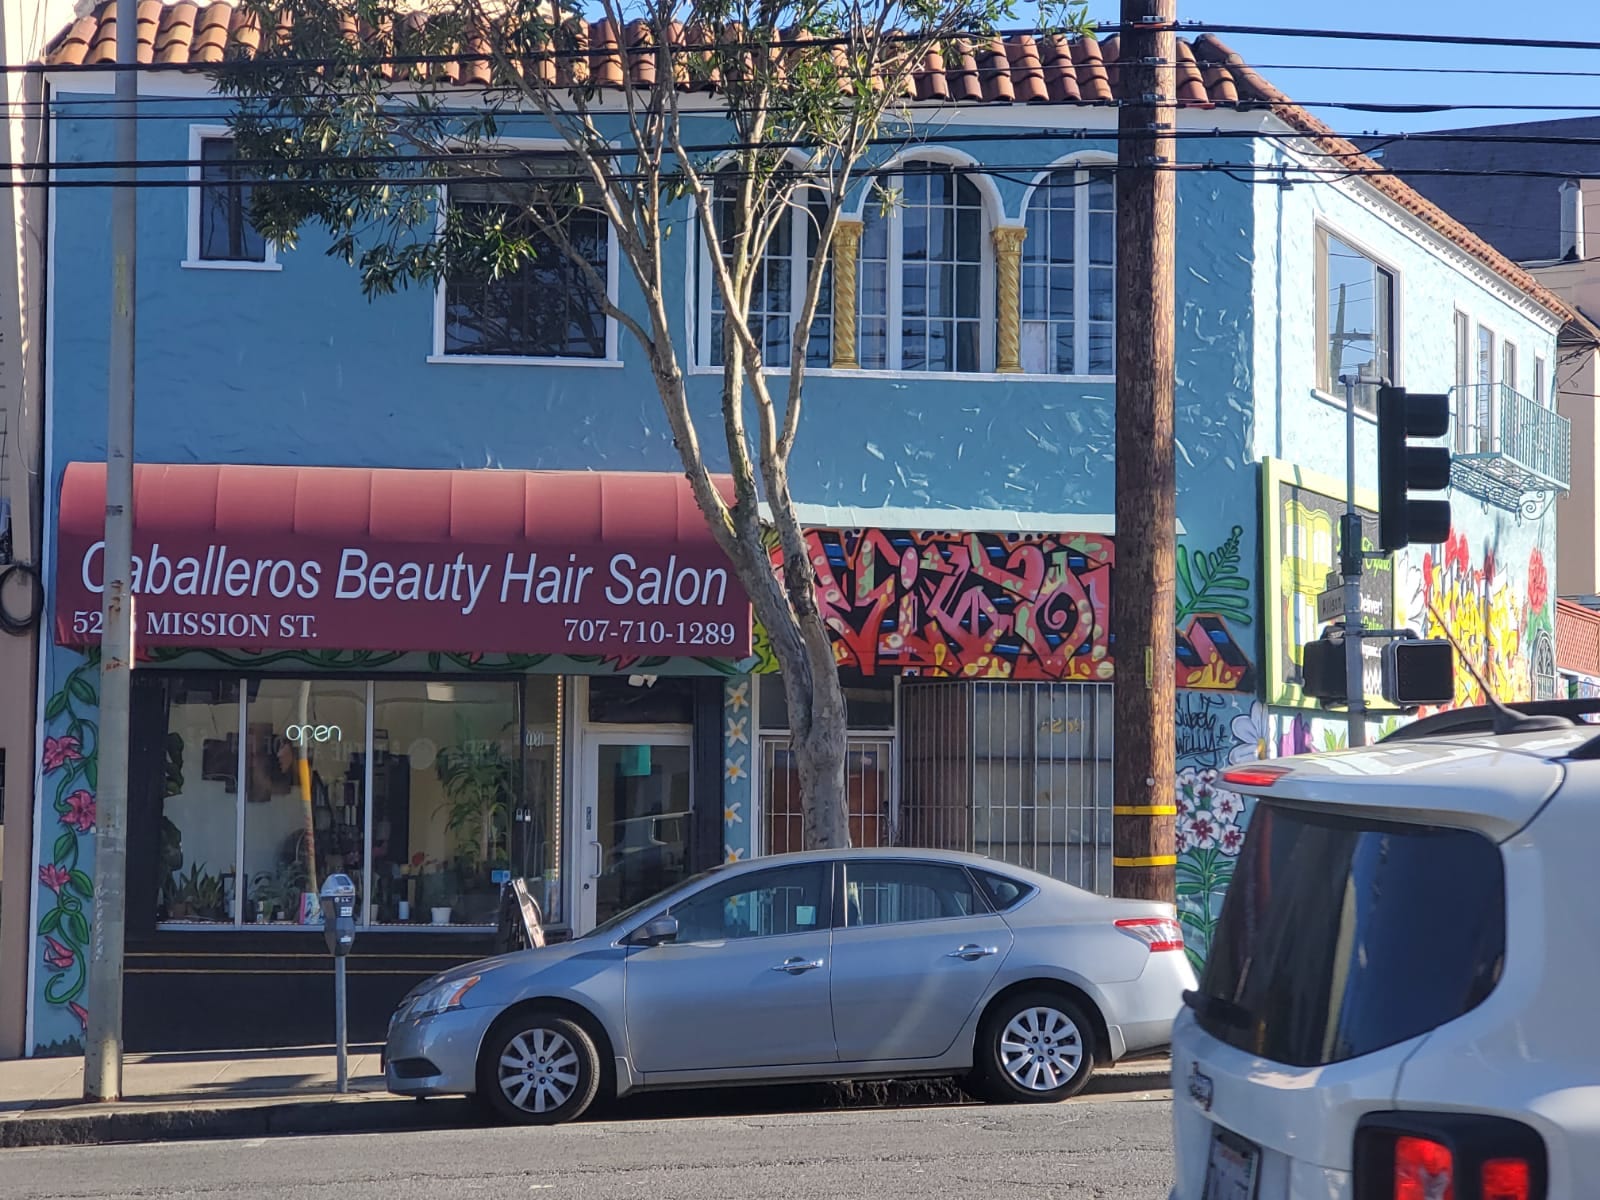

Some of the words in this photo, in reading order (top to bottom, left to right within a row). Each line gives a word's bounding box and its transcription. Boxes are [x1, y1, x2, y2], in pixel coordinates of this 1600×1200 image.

[82, 541, 322, 599] Caballeros
[335, 548, 491, 615] Beauty
[500, 552, 593, 604] Hair
[605, 553, 727, 606] Salon
[146, 612, 271, 638] MISSION
[279, 614, 317, 638] ST.
[564, 619, 736, 646] 707-710-1289
[286, 724, 342, 746] open
